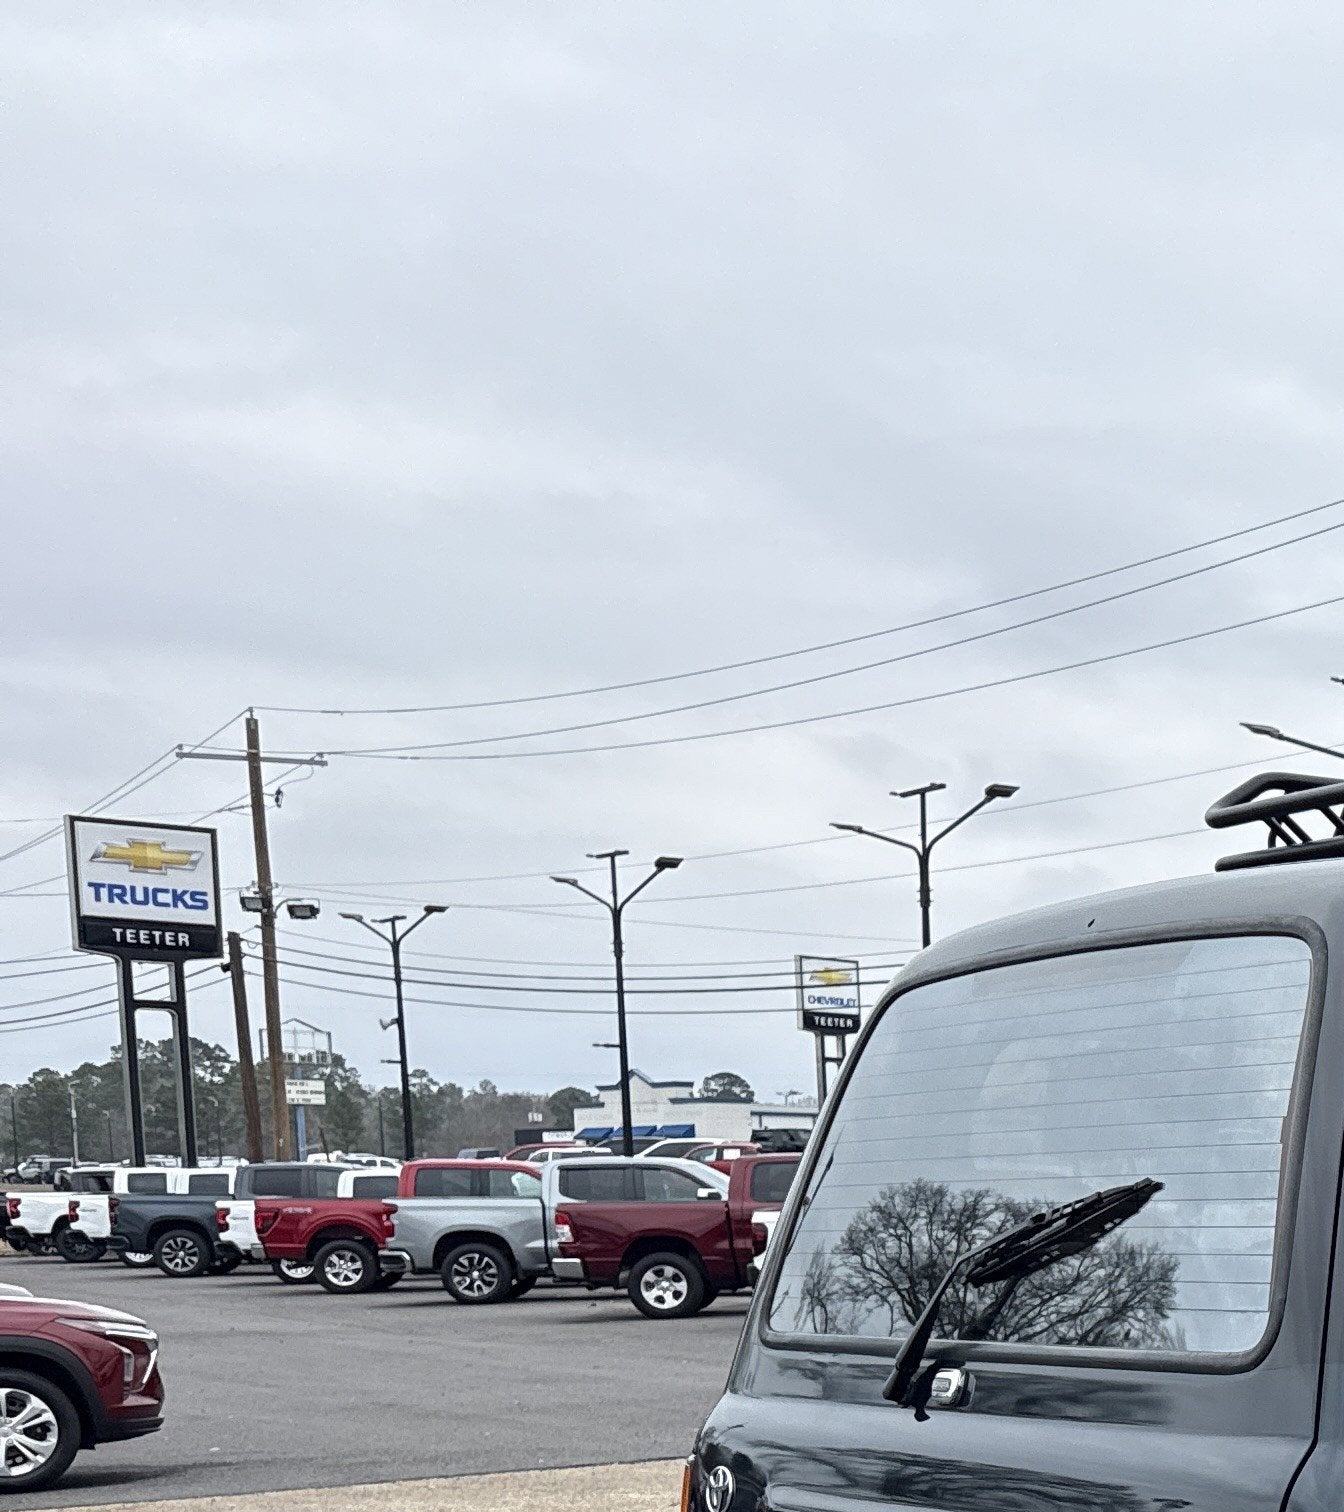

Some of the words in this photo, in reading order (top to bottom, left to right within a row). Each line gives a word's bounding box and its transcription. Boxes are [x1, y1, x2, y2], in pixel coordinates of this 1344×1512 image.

[87, 881, 209, 911] TRUCKS
[112, 927, 190, 947] TEETER
[813, 1015, 853, 1028] TEETER
